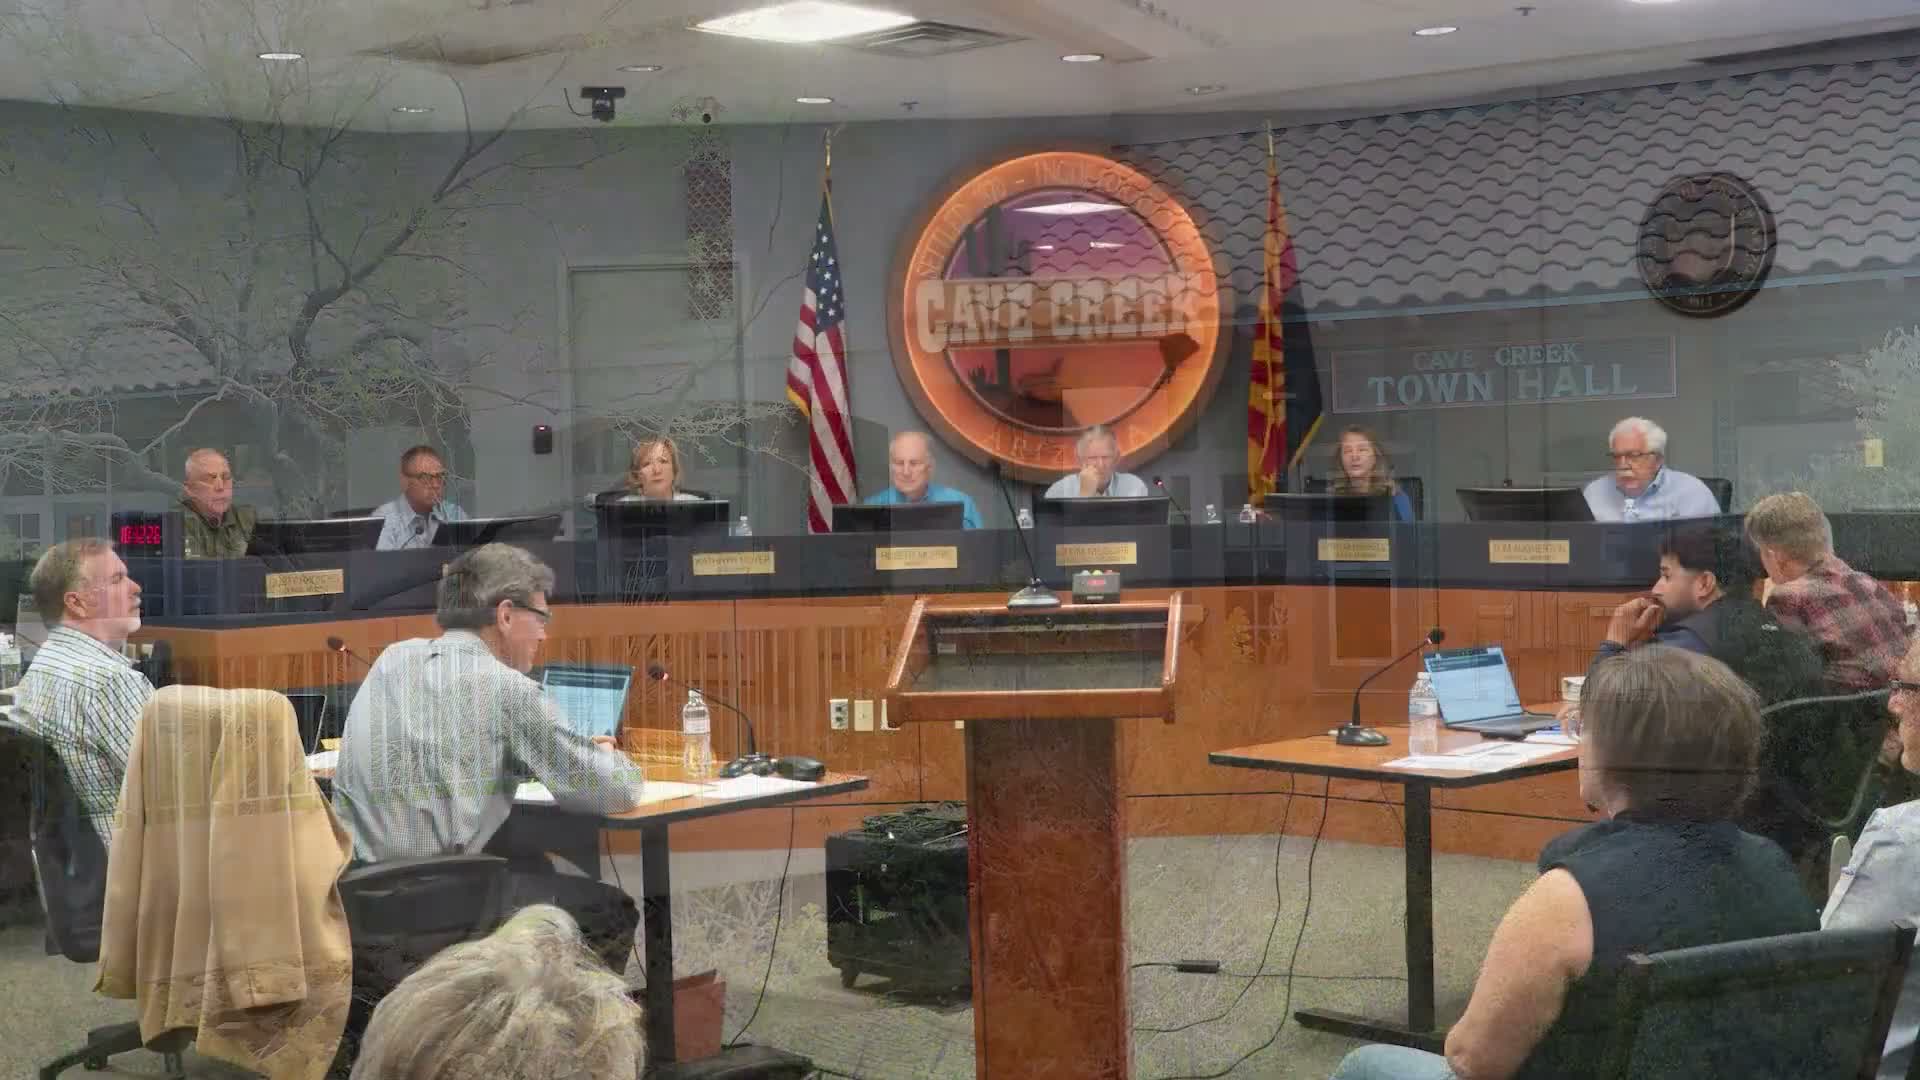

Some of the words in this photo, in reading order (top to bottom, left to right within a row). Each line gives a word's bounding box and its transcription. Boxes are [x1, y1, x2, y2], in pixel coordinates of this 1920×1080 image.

[916, 279, 1033, 352] CAVE
[1048, 272, 1201, 343] CREEK
[1413, 350, 1475, 371] CAVE
[1495, 342, 1581, 367] CREEK
[1368, 370, 1496, 407] TOWN
[1517, 363, 1639, 400] HALL
